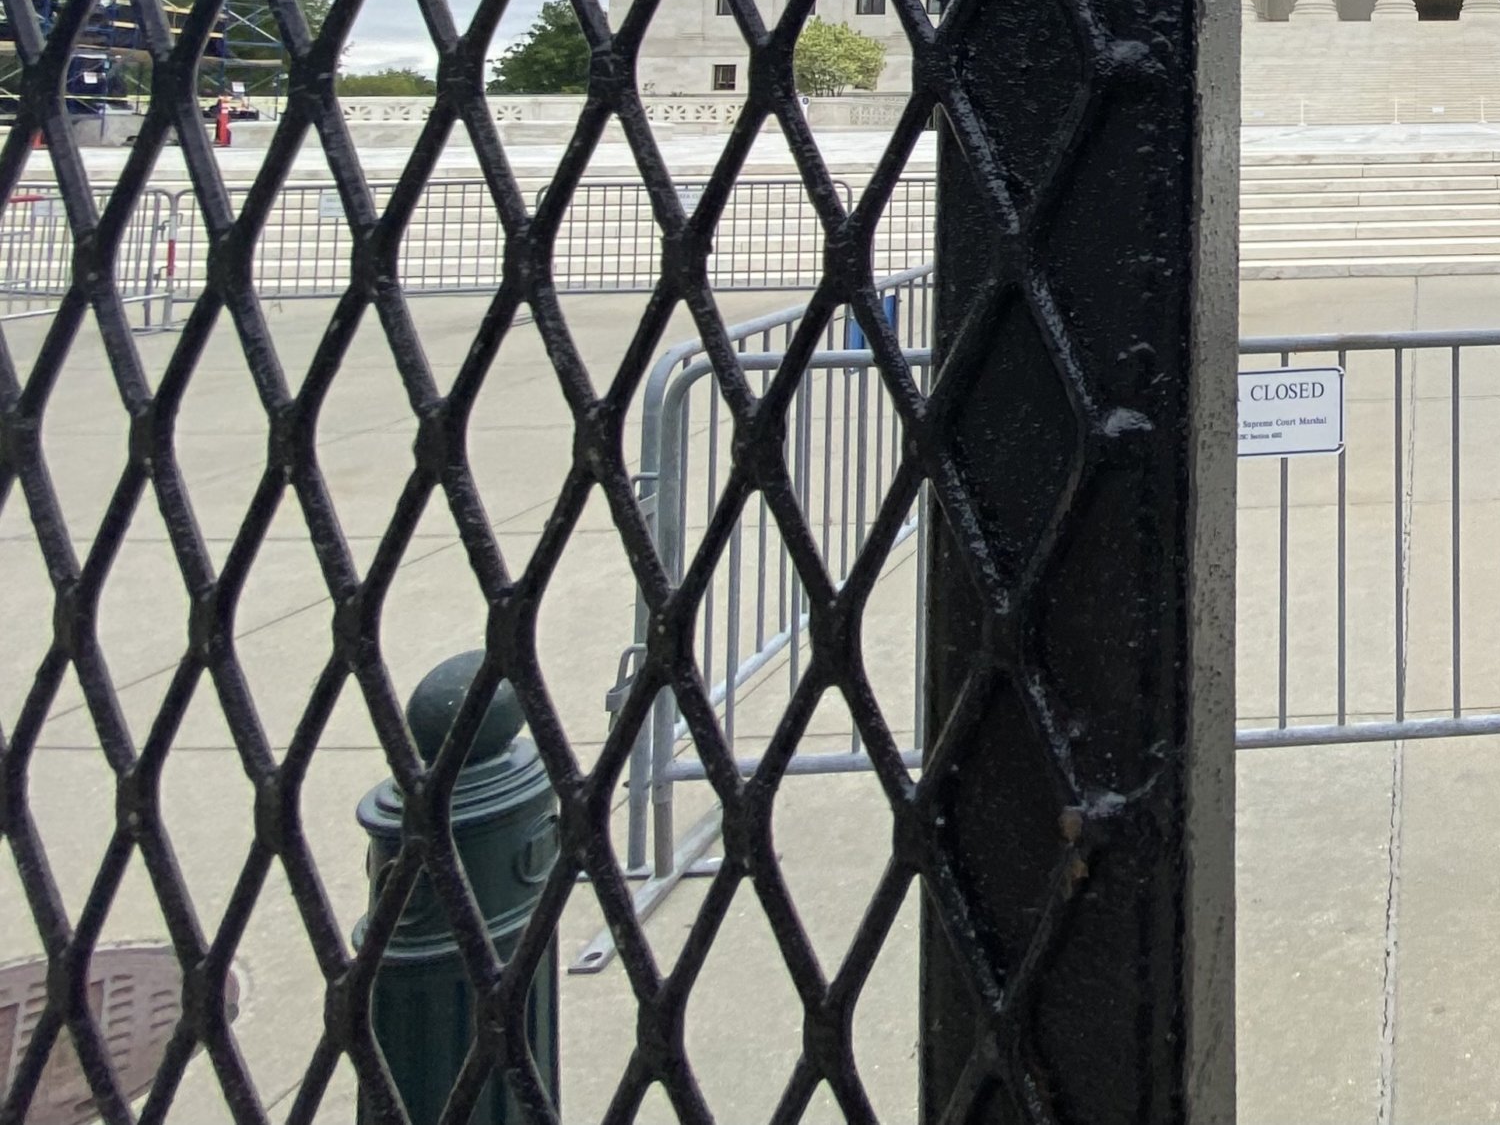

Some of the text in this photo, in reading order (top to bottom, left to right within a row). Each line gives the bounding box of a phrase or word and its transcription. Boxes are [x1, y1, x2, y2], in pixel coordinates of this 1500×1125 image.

[1250, 381, 1325, 401] CLOSED
[1242, 416, 1327, 429] Supreme Court Marshal
